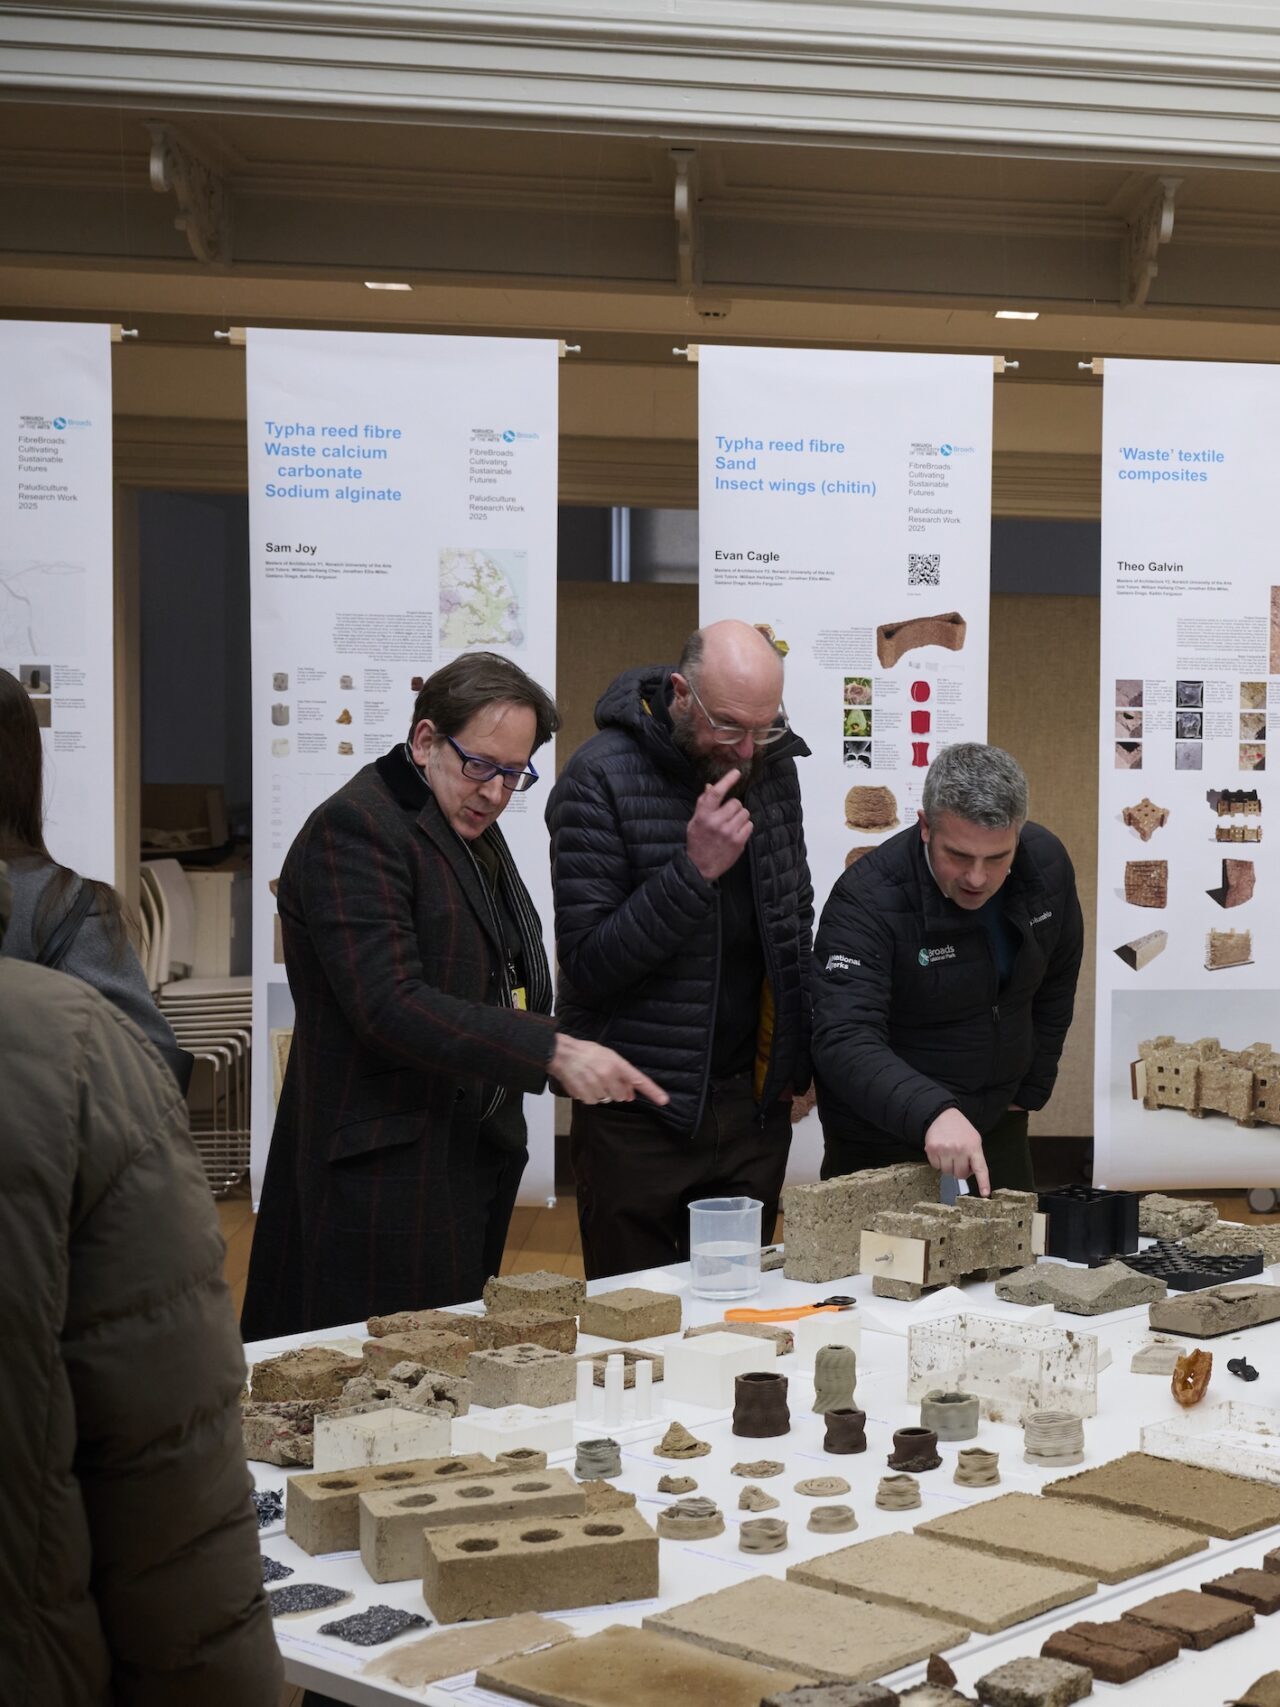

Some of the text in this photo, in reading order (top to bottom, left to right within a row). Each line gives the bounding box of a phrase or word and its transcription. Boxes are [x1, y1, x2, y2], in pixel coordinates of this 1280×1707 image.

[264, 421, 402, 440] Typha reed fibre
[18, 445, 59, 455] Cultivating
[715, 436, 846, 454] Typha reed fibre
[264, 442, 387, 459] Waste calcium
[18, 454, 64, 464] Sustainable
[1178, 449, 1225, 463] textile
[469, 458, 508, 467] Cultivating
[715, 456, 757, 471] Sand
[18, 464, 48, 473] Futures
[278, 464, 363, 479] carbonate
[469, 467, 512, 476] Sustainable
[469, 476, 497, 484] Futures
[908, 471, 945, 480] Cultivating
[1118, 468, 1208, 484] composites
[18, 483, 68, 492] Paludiculture
[715, 477, 877, 498] Insect wings (chitin)
[908, 480, 949, 488] Sustainable
[18, 492, 78, 502] Research Work
[265, 484, 402, 503] Sodium alginate
[469, 495, 516, 503] Paludiculture
[18, 502, 38, 510] 2025
[469, 504, 525, 513] Research Work
[908, 507, 953, 515] Paludiculture
[469, 513, 487, 521] 2025
[908, 516, 961, 525] Research Work
[265, 542, 318, 556] Sam Joy
[715, 550, 780, 564] Evan Cagle
[1117, 561, 1184, 573] Theo Galvin
[928, 945, 955, 957] Broads
